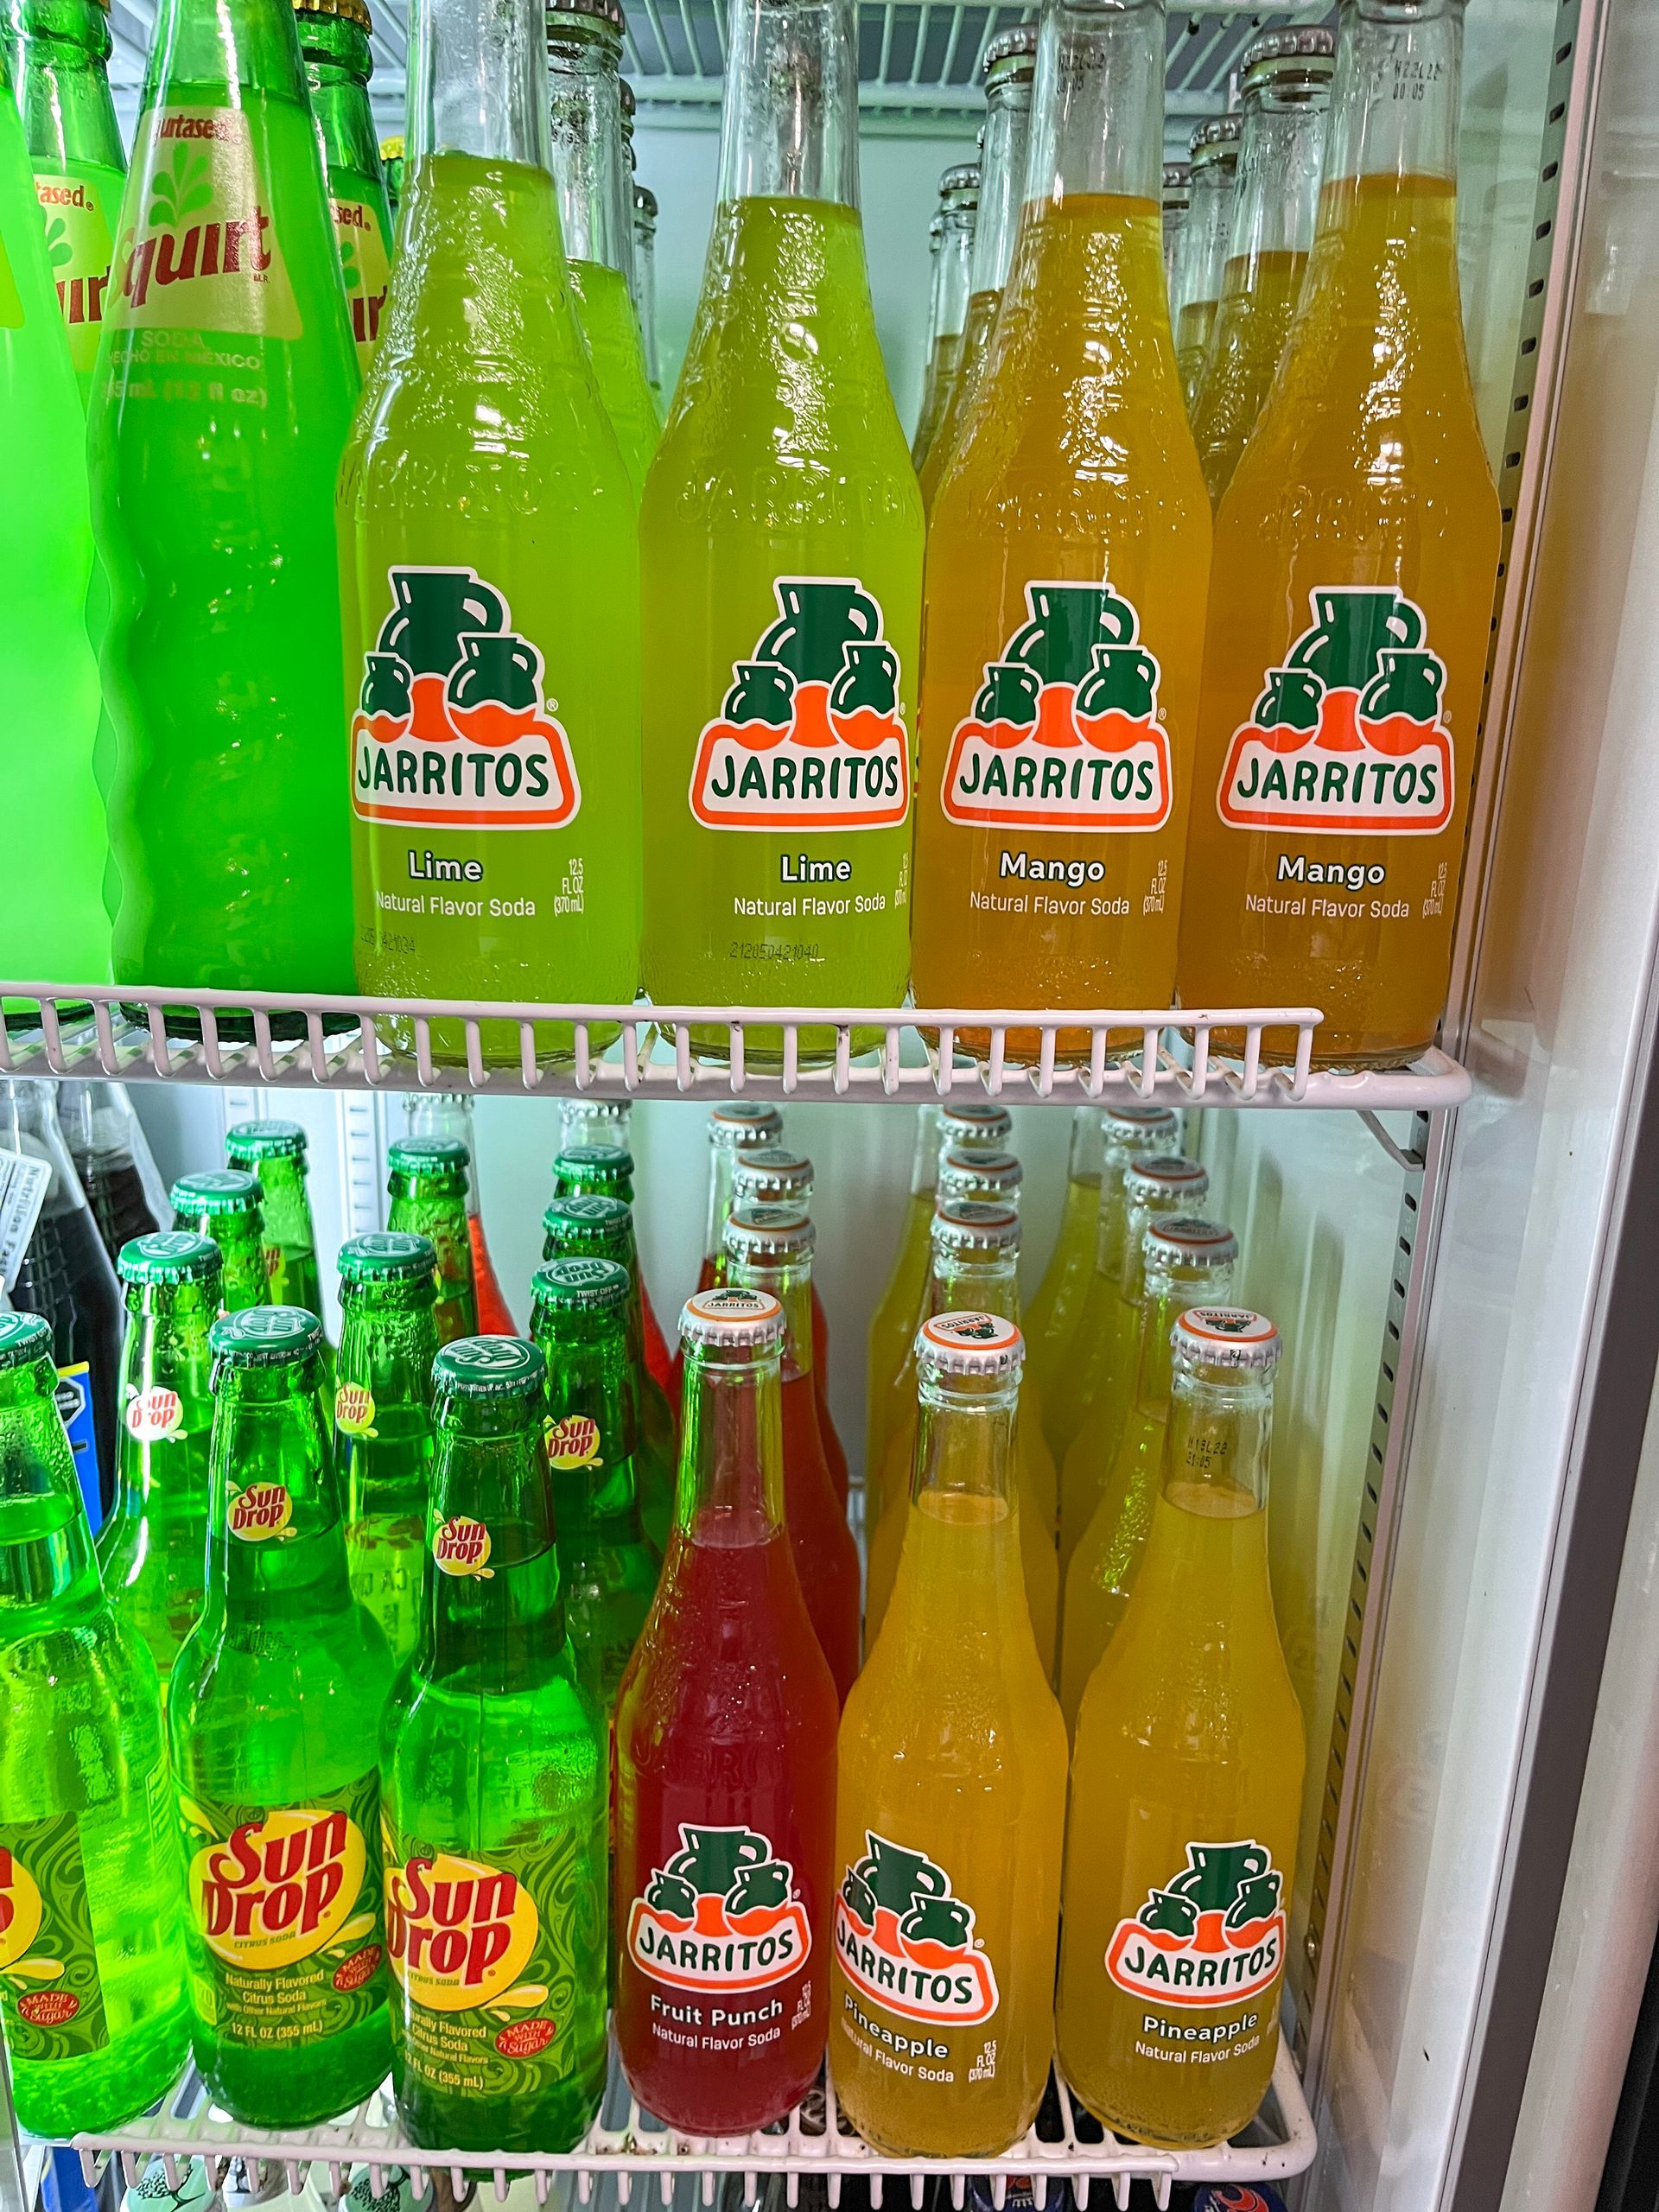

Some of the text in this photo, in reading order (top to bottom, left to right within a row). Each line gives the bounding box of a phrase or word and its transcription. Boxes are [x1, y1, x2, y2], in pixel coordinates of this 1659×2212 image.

[142, 331, 206, 348] SODA
[358, 746, 549, 797] JARRITOS
[711, 755, 898, 799] JARRITOS
[959, 753, 1154, 801] JARRITOS
[1237, 758, 1438, 804] JARRITOS
[408, 849, 483, 881] Lime
[569, 857, 584, 876] 12.5
[780, 854, 852, 883] Lime
[999, 850, 1105, 887] Mango
[1277, 854, 1386, 891] Mango
[563, 877, 584, 894] FL OZ
[375, 890, 536, 917] Natural Flavor Soda
[554, 895, 570, 917] (370
[734, 893, 886, 916] Natural Flavor Soda
[969, 891, 1129, 916] Natural Flavor Soda
[1245, 893, 1409, 918] Natural Flavor Soda
[576, 1288, 598, 1298] TWIST
[941, 1316, 985, 1329] JARRITOS
[340, 1382, 370, 1404] Sun
[132, 1409, 175, 1428] Dop
[337, 1401, 367, 1423] Drop
[552, 1417, 595, 1439] Sun
[548, 1435, 593, 1458] Drop
[238, 1485, 286, 1510] Sun
[232, 1503, 283, 1529] Drop
[442, 1516, 486, 1541] Sun
[436, 1538, 482, 1564] Drop
[209, 1811, 347, 1889] Sun
[202, 1862, 343, 1936] Drop
[391, 1858, 518, 1927] Sun
[234, 1931, 296, 1949] CITRUS SODA
[388, 1904, 511, 1986] Drop
[639, 1927, 793, 1972] JARRITOS
[836, 1919, 973, 2005] JARRITOS
[1124, 1937, 1277, 1987] JARRITOS
[226, 1969, 324, 1993] Naturally Flavored
[243, 1989, 307, 2005] Citrus Soda
[651, 1994, 702, 2025] Fruit
[711, 1999, 783, 2026] Punch
[232, 2019, 323, 2040] 12 FL OZ (355 mL)
[409, 2009, 486, 2037] urally Flavored
[506, 2020, 548, 2037] MADE
[652, 2022, 781, 2050] Natural Flavor Soda
[843, 1993, 949, 2059] Pineapple
[1143, 2012, 1258, 2044] Pineapple
[411, 2023, 438, 2045] Citrus
[441, 2036, 468, 2051] Soda
[1135, 2034, 1260, 2063] Natural Flavor Soda
[413, 2056, 423, 2073] FL
[424, 2064, 436, 2080] OZ
[439, 2070, 461, 2086] (355
[463, 2075, 484, 2090] mL)
[874, 2049, 914, 2076] Flavor
[918, 2066, 954, 2083] Soda
